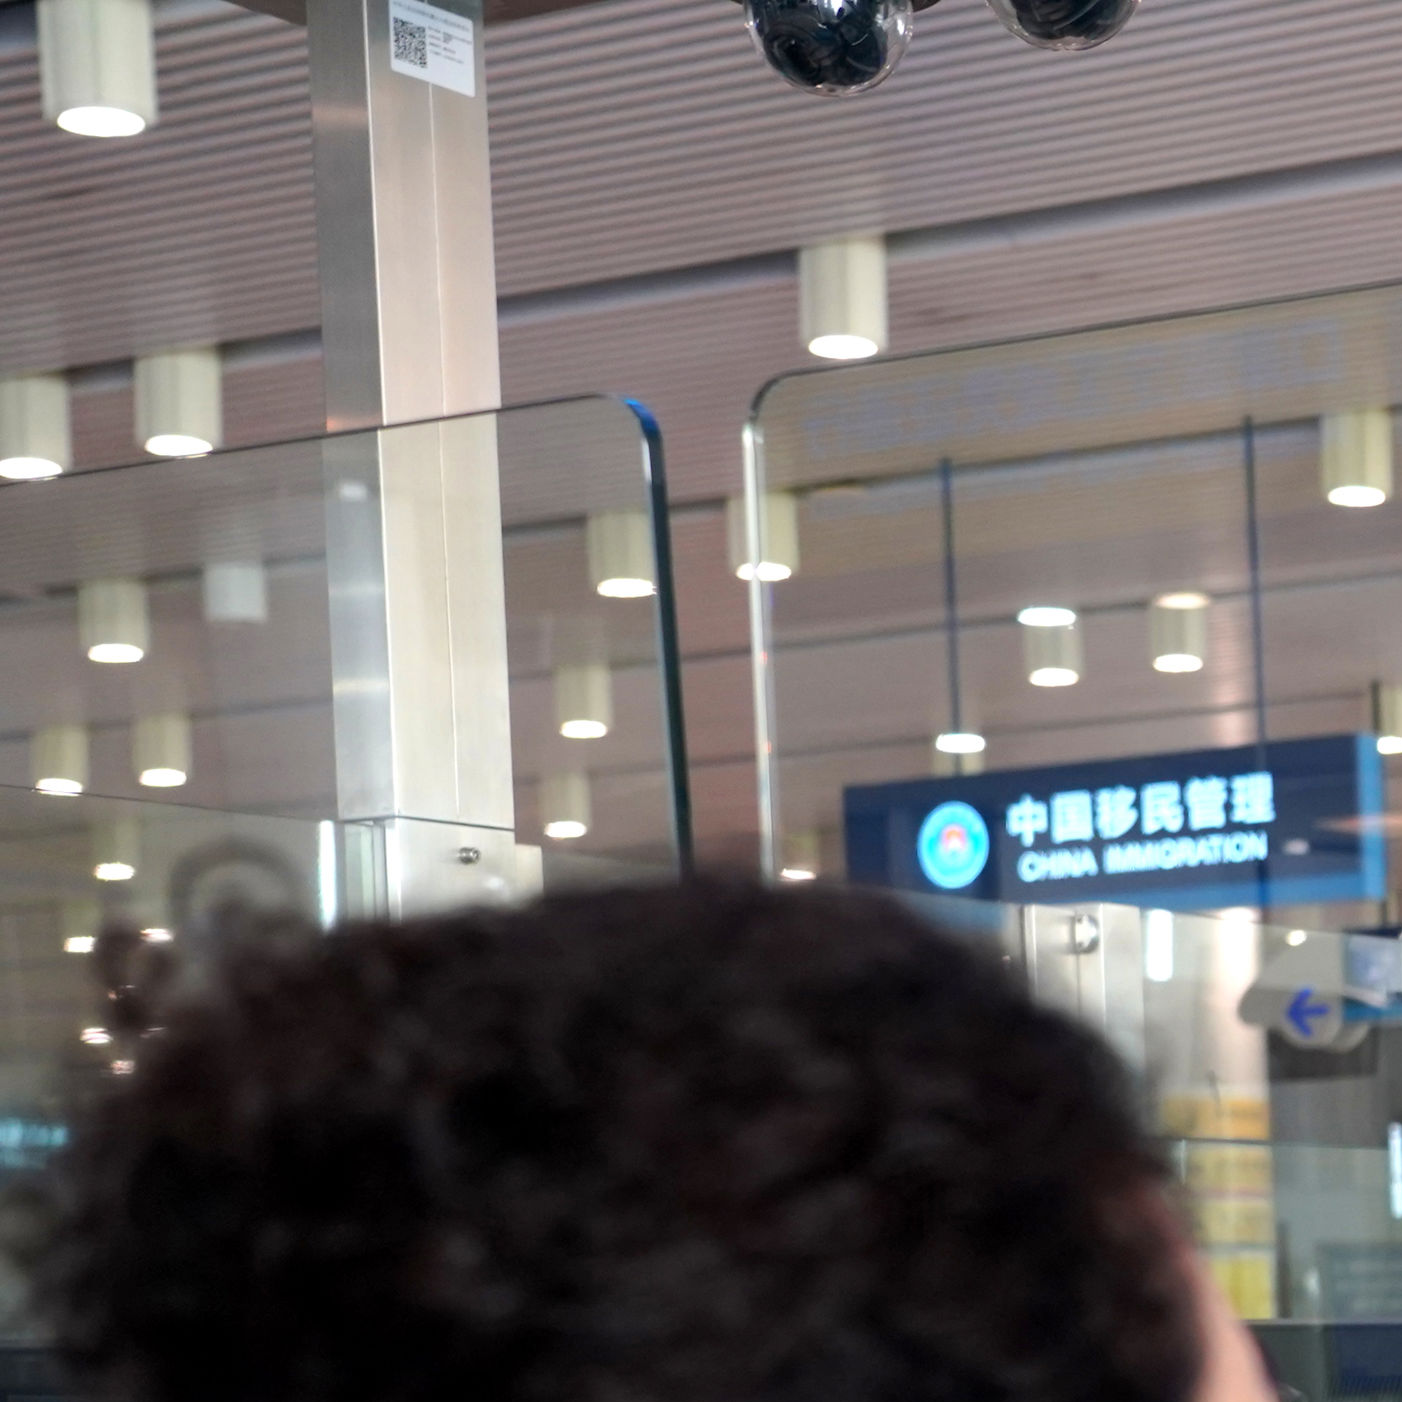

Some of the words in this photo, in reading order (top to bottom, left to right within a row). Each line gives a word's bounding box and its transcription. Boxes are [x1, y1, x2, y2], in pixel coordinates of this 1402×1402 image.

[1006, 771, 1276, 848] 中国移民管理
[1017, 847, 1098, 883] CHINA
[1102, 829, 1268, 875] IMMIGRATION
